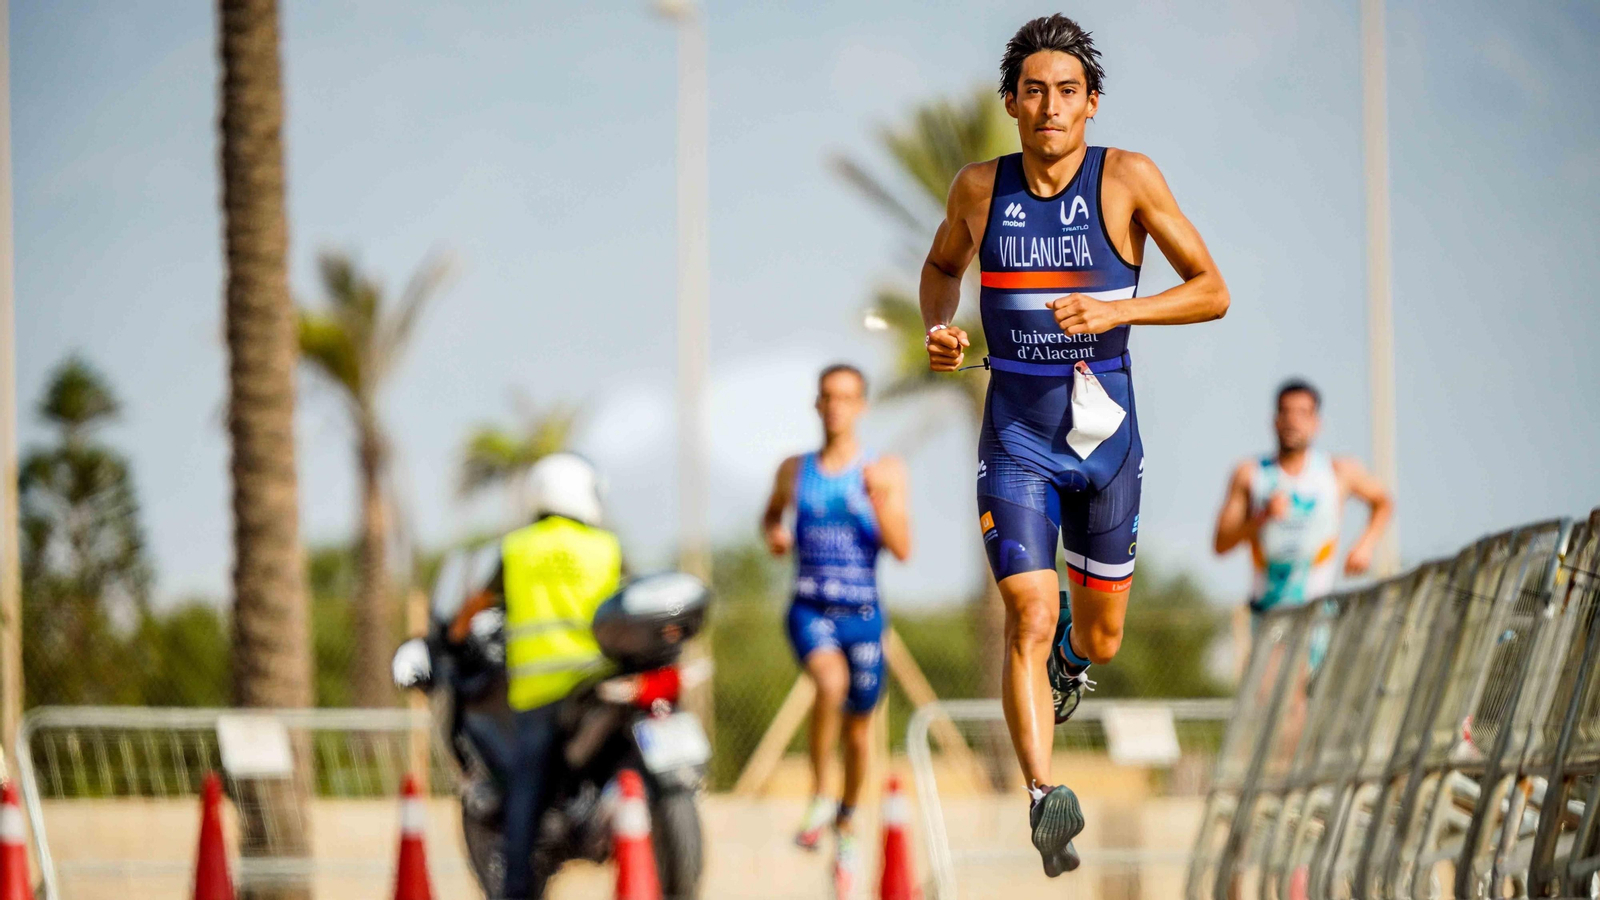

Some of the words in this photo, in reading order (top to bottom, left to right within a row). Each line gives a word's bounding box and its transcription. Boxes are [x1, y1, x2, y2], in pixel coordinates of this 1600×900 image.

[1002, 220, 1025, 228] mobel
[1000, 234, 1093, 267] VILLANUEVA
[1011, 329, 1099, 344] Universitat
